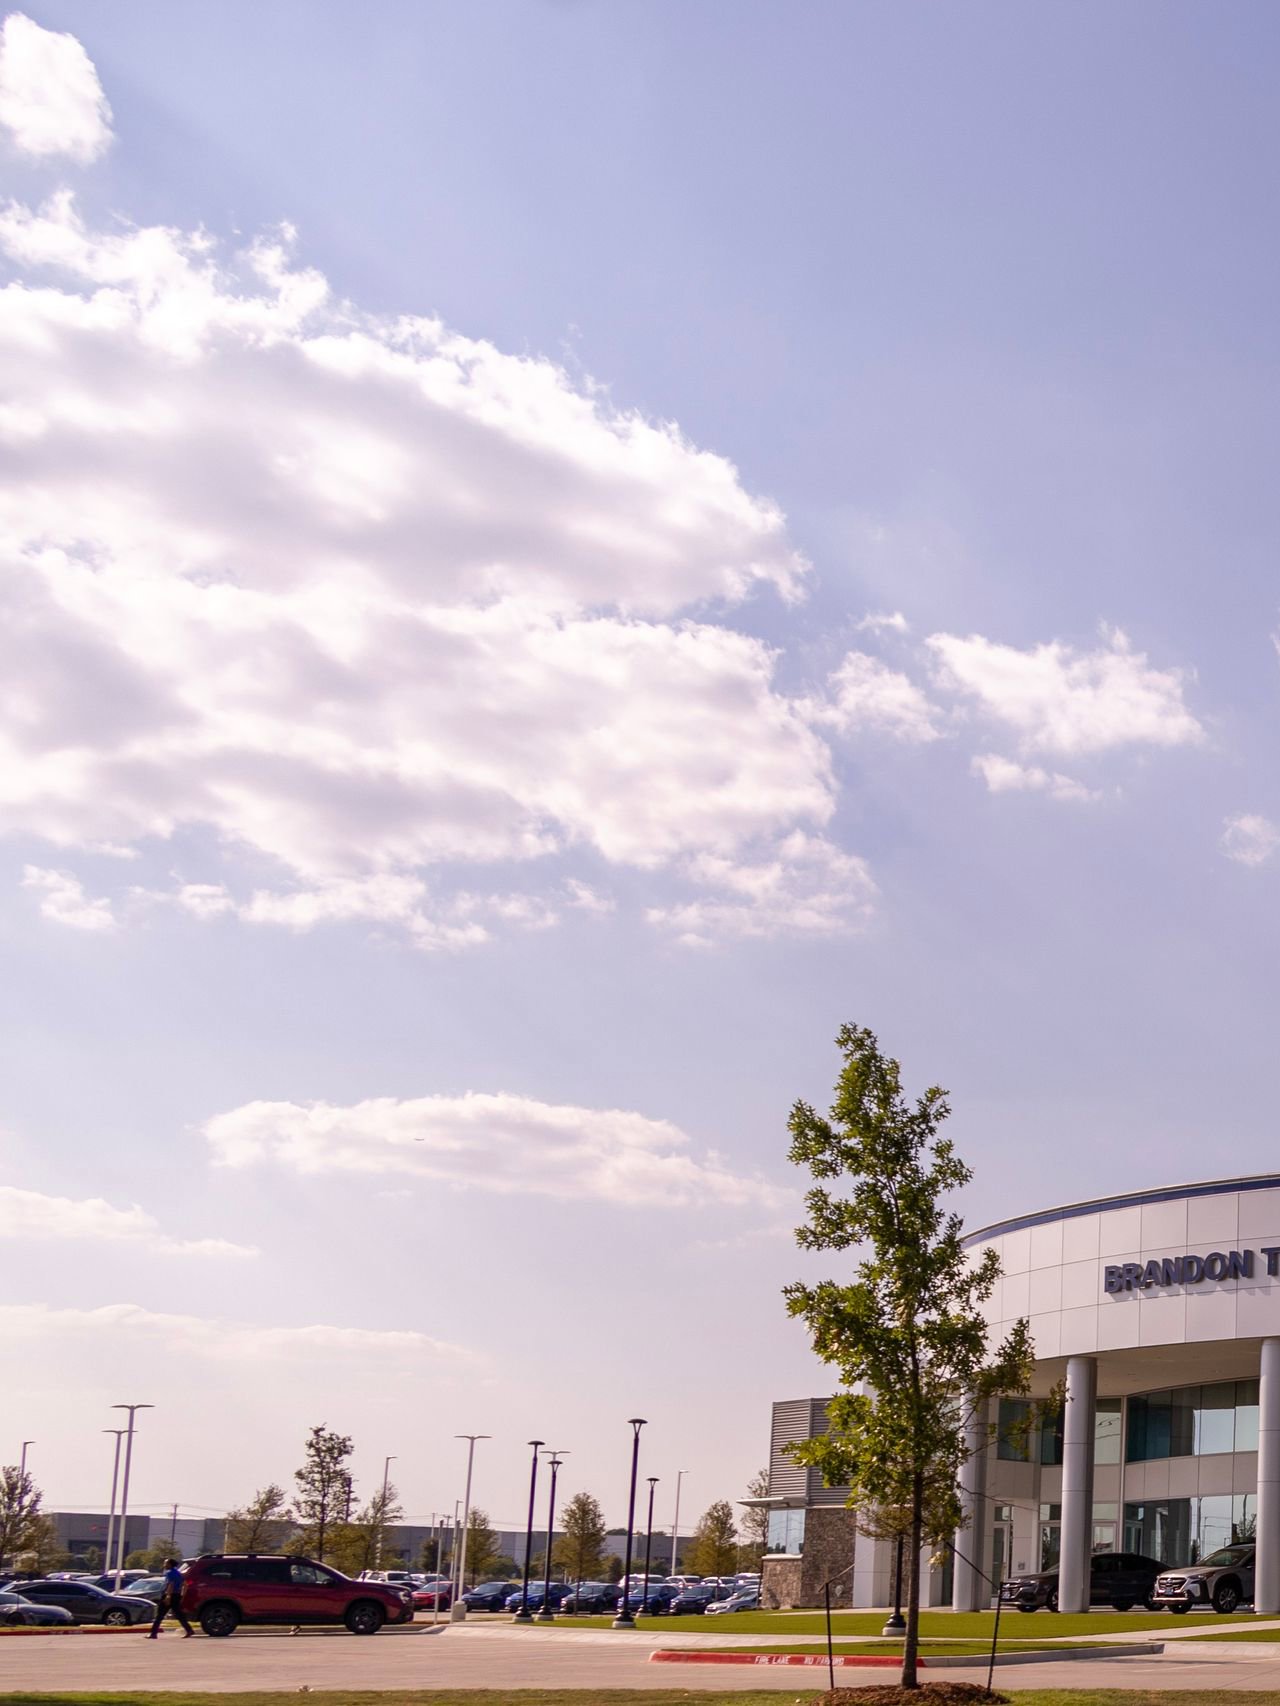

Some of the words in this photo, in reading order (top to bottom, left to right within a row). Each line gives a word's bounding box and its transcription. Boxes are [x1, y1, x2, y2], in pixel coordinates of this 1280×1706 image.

[1104, 1249, 1254, 1293] BRANDON
[754, 1655, 770, 1665] FIRE
[816, 1656, 845, 1666] PARING
